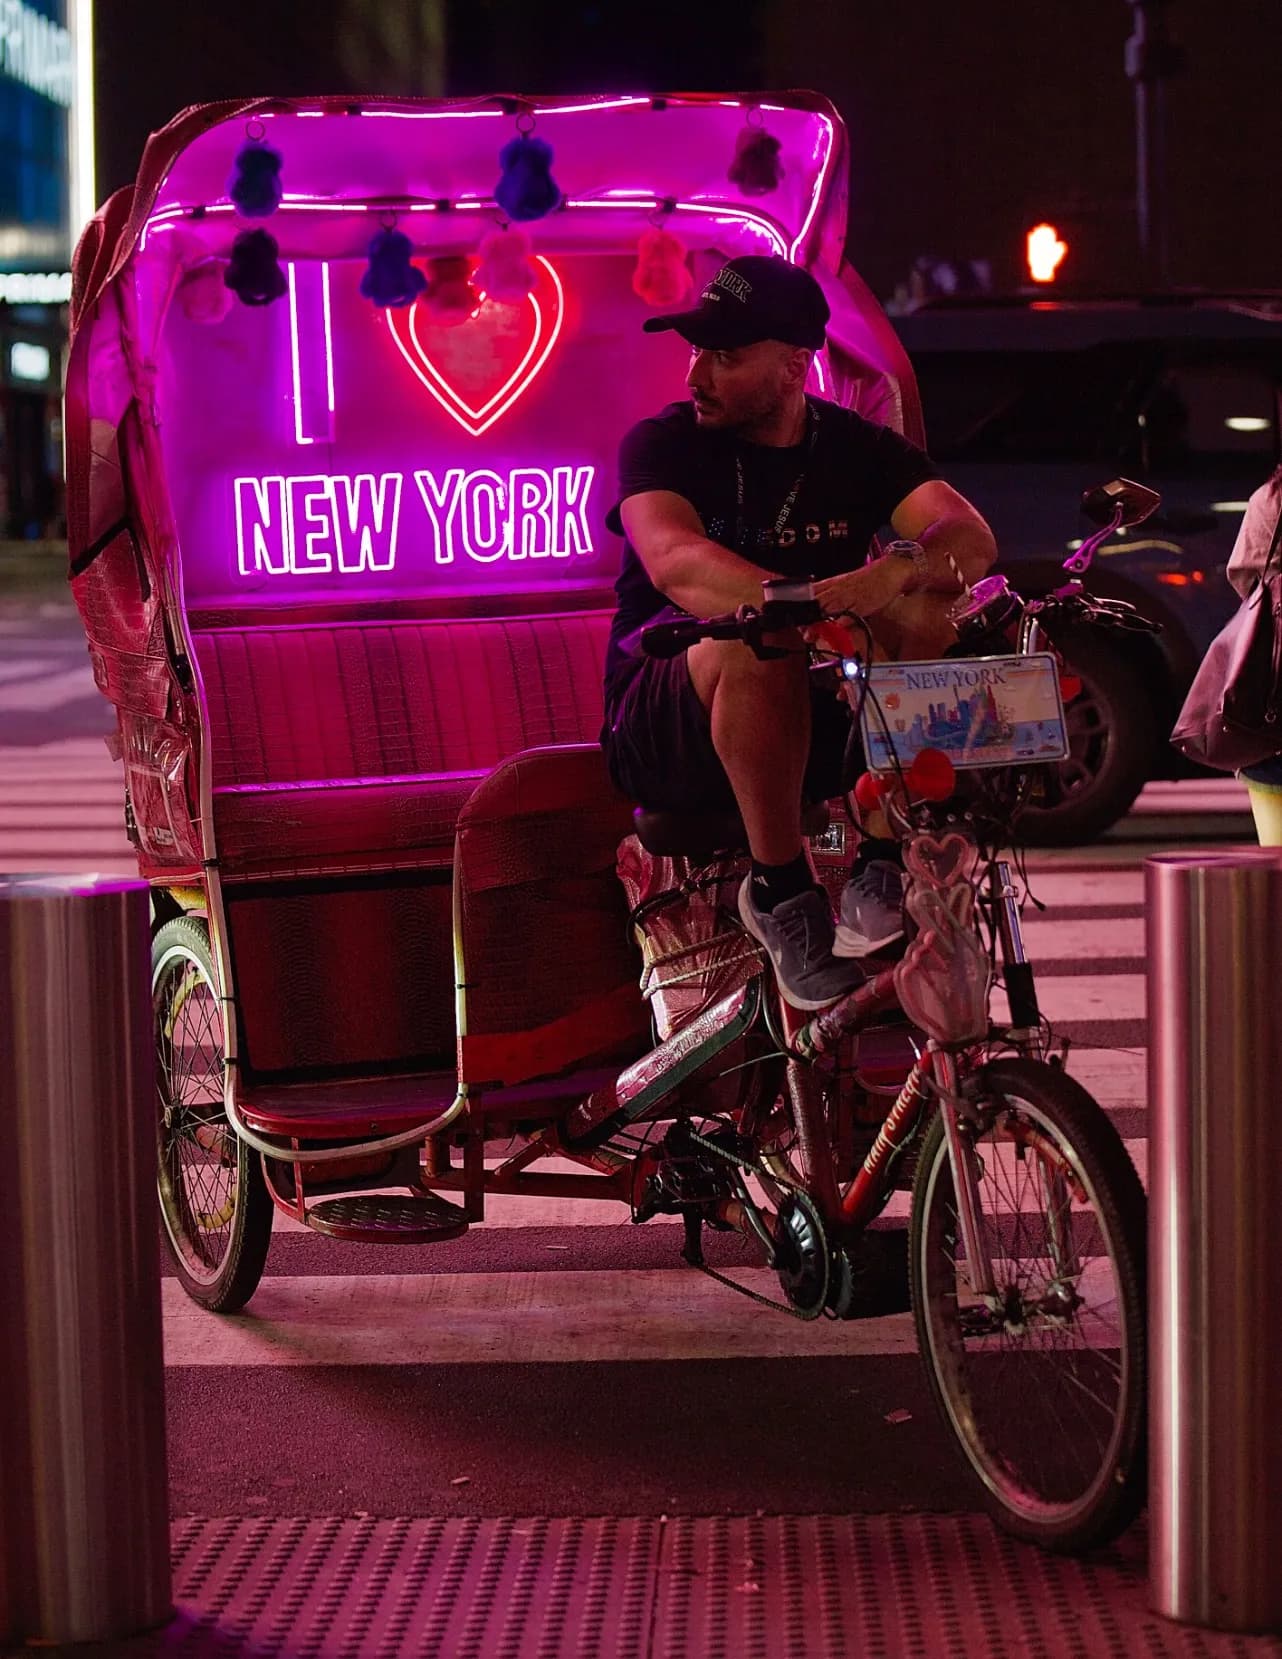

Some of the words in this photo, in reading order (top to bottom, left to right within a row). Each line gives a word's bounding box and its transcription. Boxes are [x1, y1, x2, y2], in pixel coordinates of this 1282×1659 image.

[234, 473, 403, 575] NEW
[414, 466, 595, 564] YORK
[774, 504, 791, 533] JESUS
[905, 672, 949, 690] NEW
[953, 667, 1007, 688] YORK
